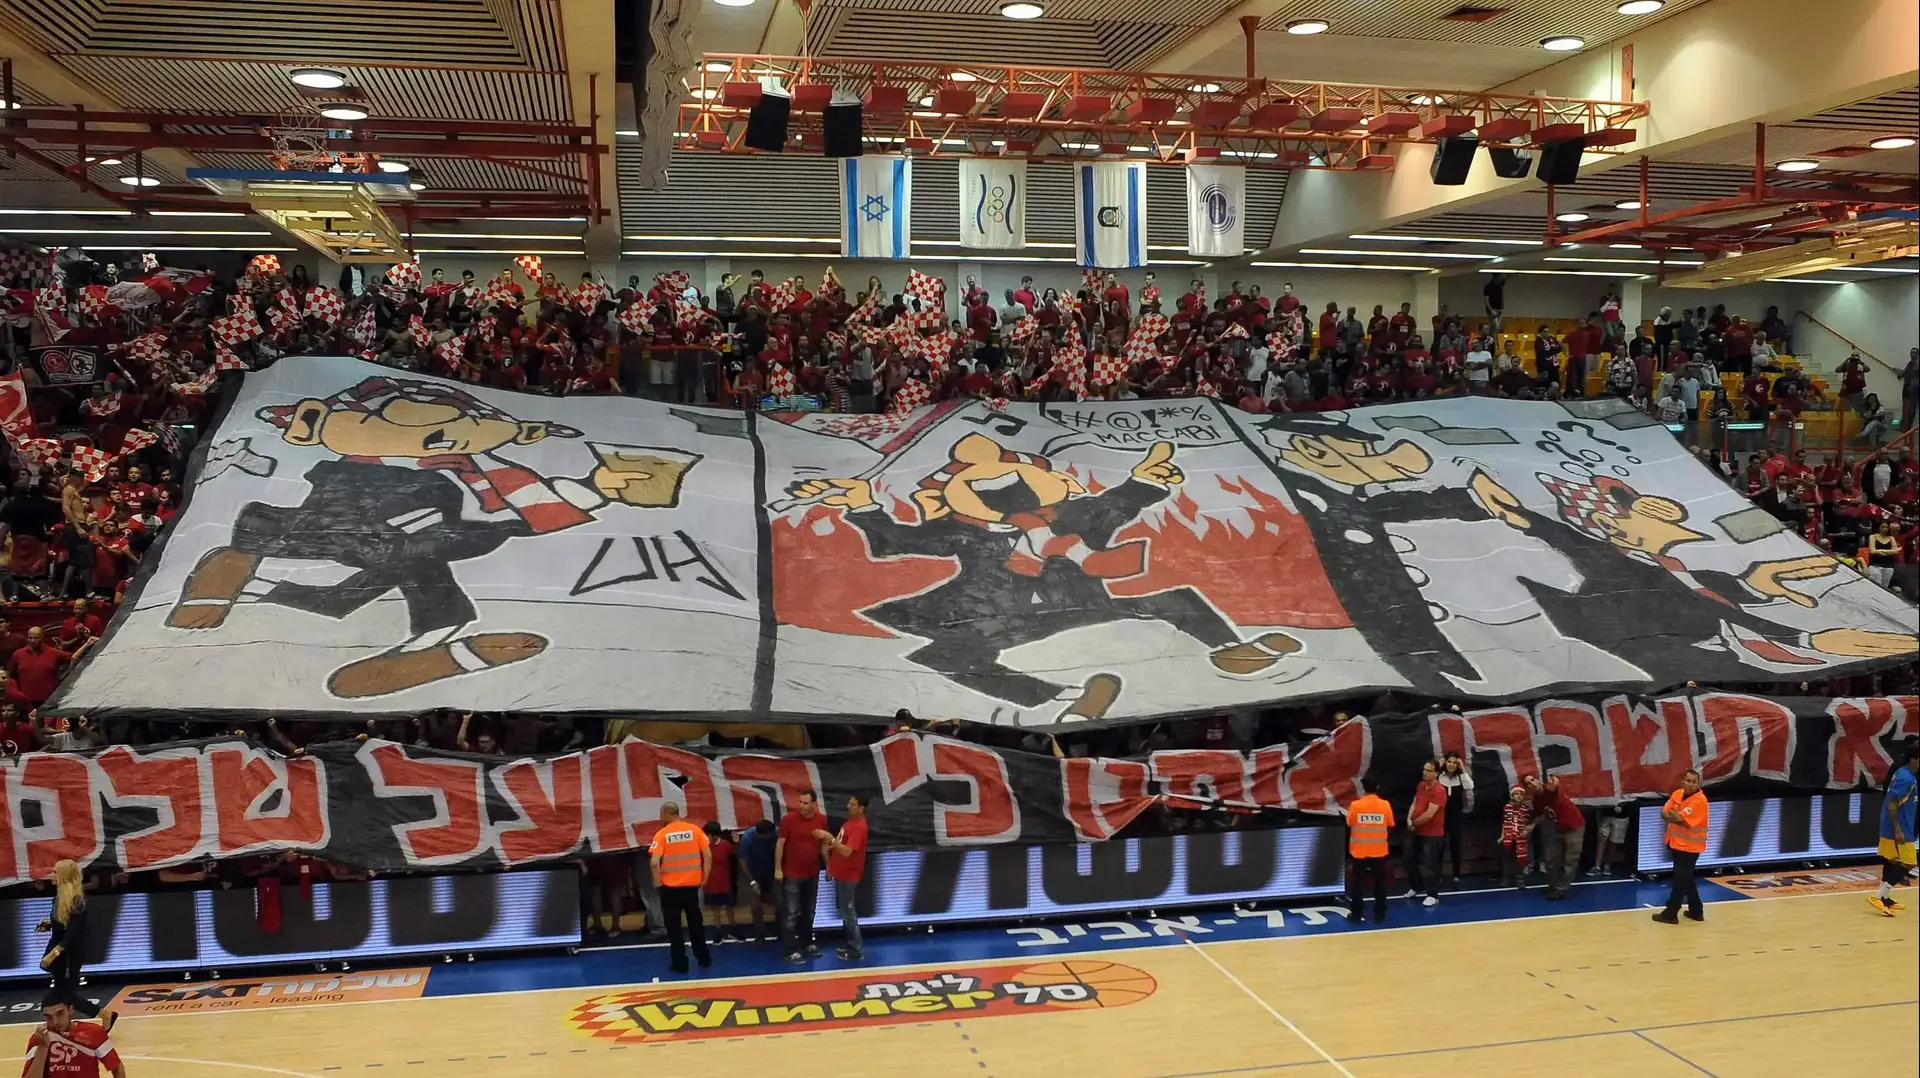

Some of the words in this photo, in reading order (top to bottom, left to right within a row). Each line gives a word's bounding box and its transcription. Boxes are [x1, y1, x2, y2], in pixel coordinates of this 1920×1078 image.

[1093, 425, 1222, 444] MACCABI
[1826, 695, 1919, 790] א
[870, 731, 1022, 847] כי
[0, 739, 331, 887] שלכ
[1360, 814, 1382, 822] סדרן
[668, 832, 691, 843] סדרן
[1006, 905, 1353, 947] תל-אביב
[257, 971, 423, 996] שלמה
[864, 973, 974, 999] ליגת
[1002, 982, 1089, 1004] סל
[145, 1000, 184, 1012] rent
[210, 1000, 241, 1009] car
[269, 992, 345, 1005] leasing
[50, 1042, 78, 1063] SP
